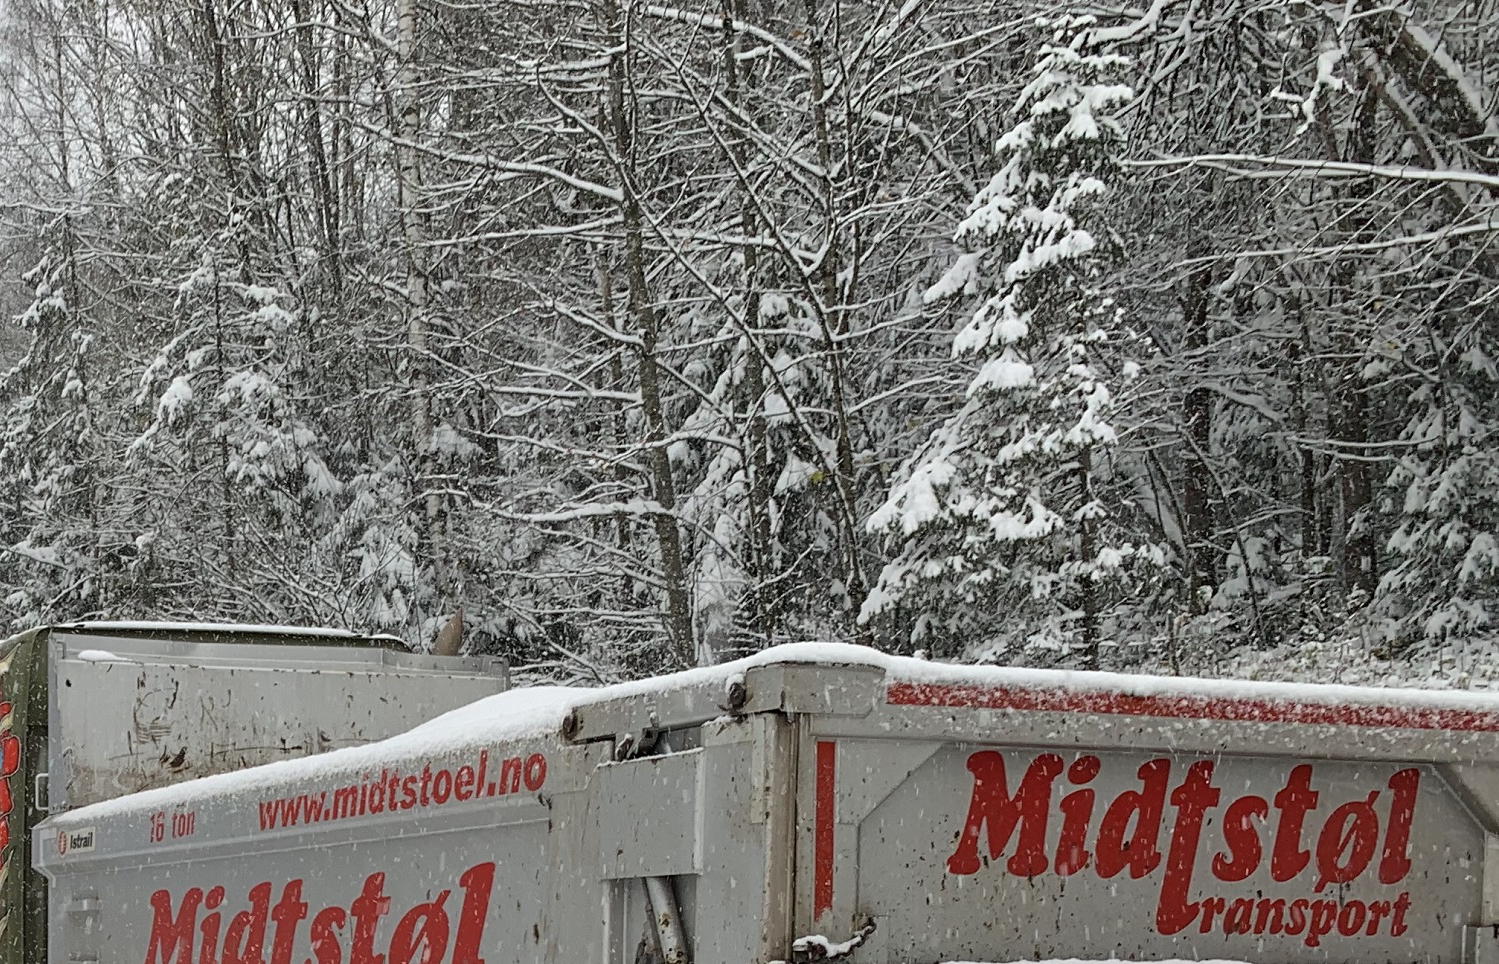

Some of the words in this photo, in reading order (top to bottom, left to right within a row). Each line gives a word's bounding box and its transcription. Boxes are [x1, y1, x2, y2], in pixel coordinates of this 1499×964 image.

[259, 751, 548, 831] www.midtstoel.no
[69, 832, 93, 850] Istrail
[150, 810, 165, 843] 16
[172, 810, 195, 838] ton
[948, 751, 1420, 936] Midtstøl
